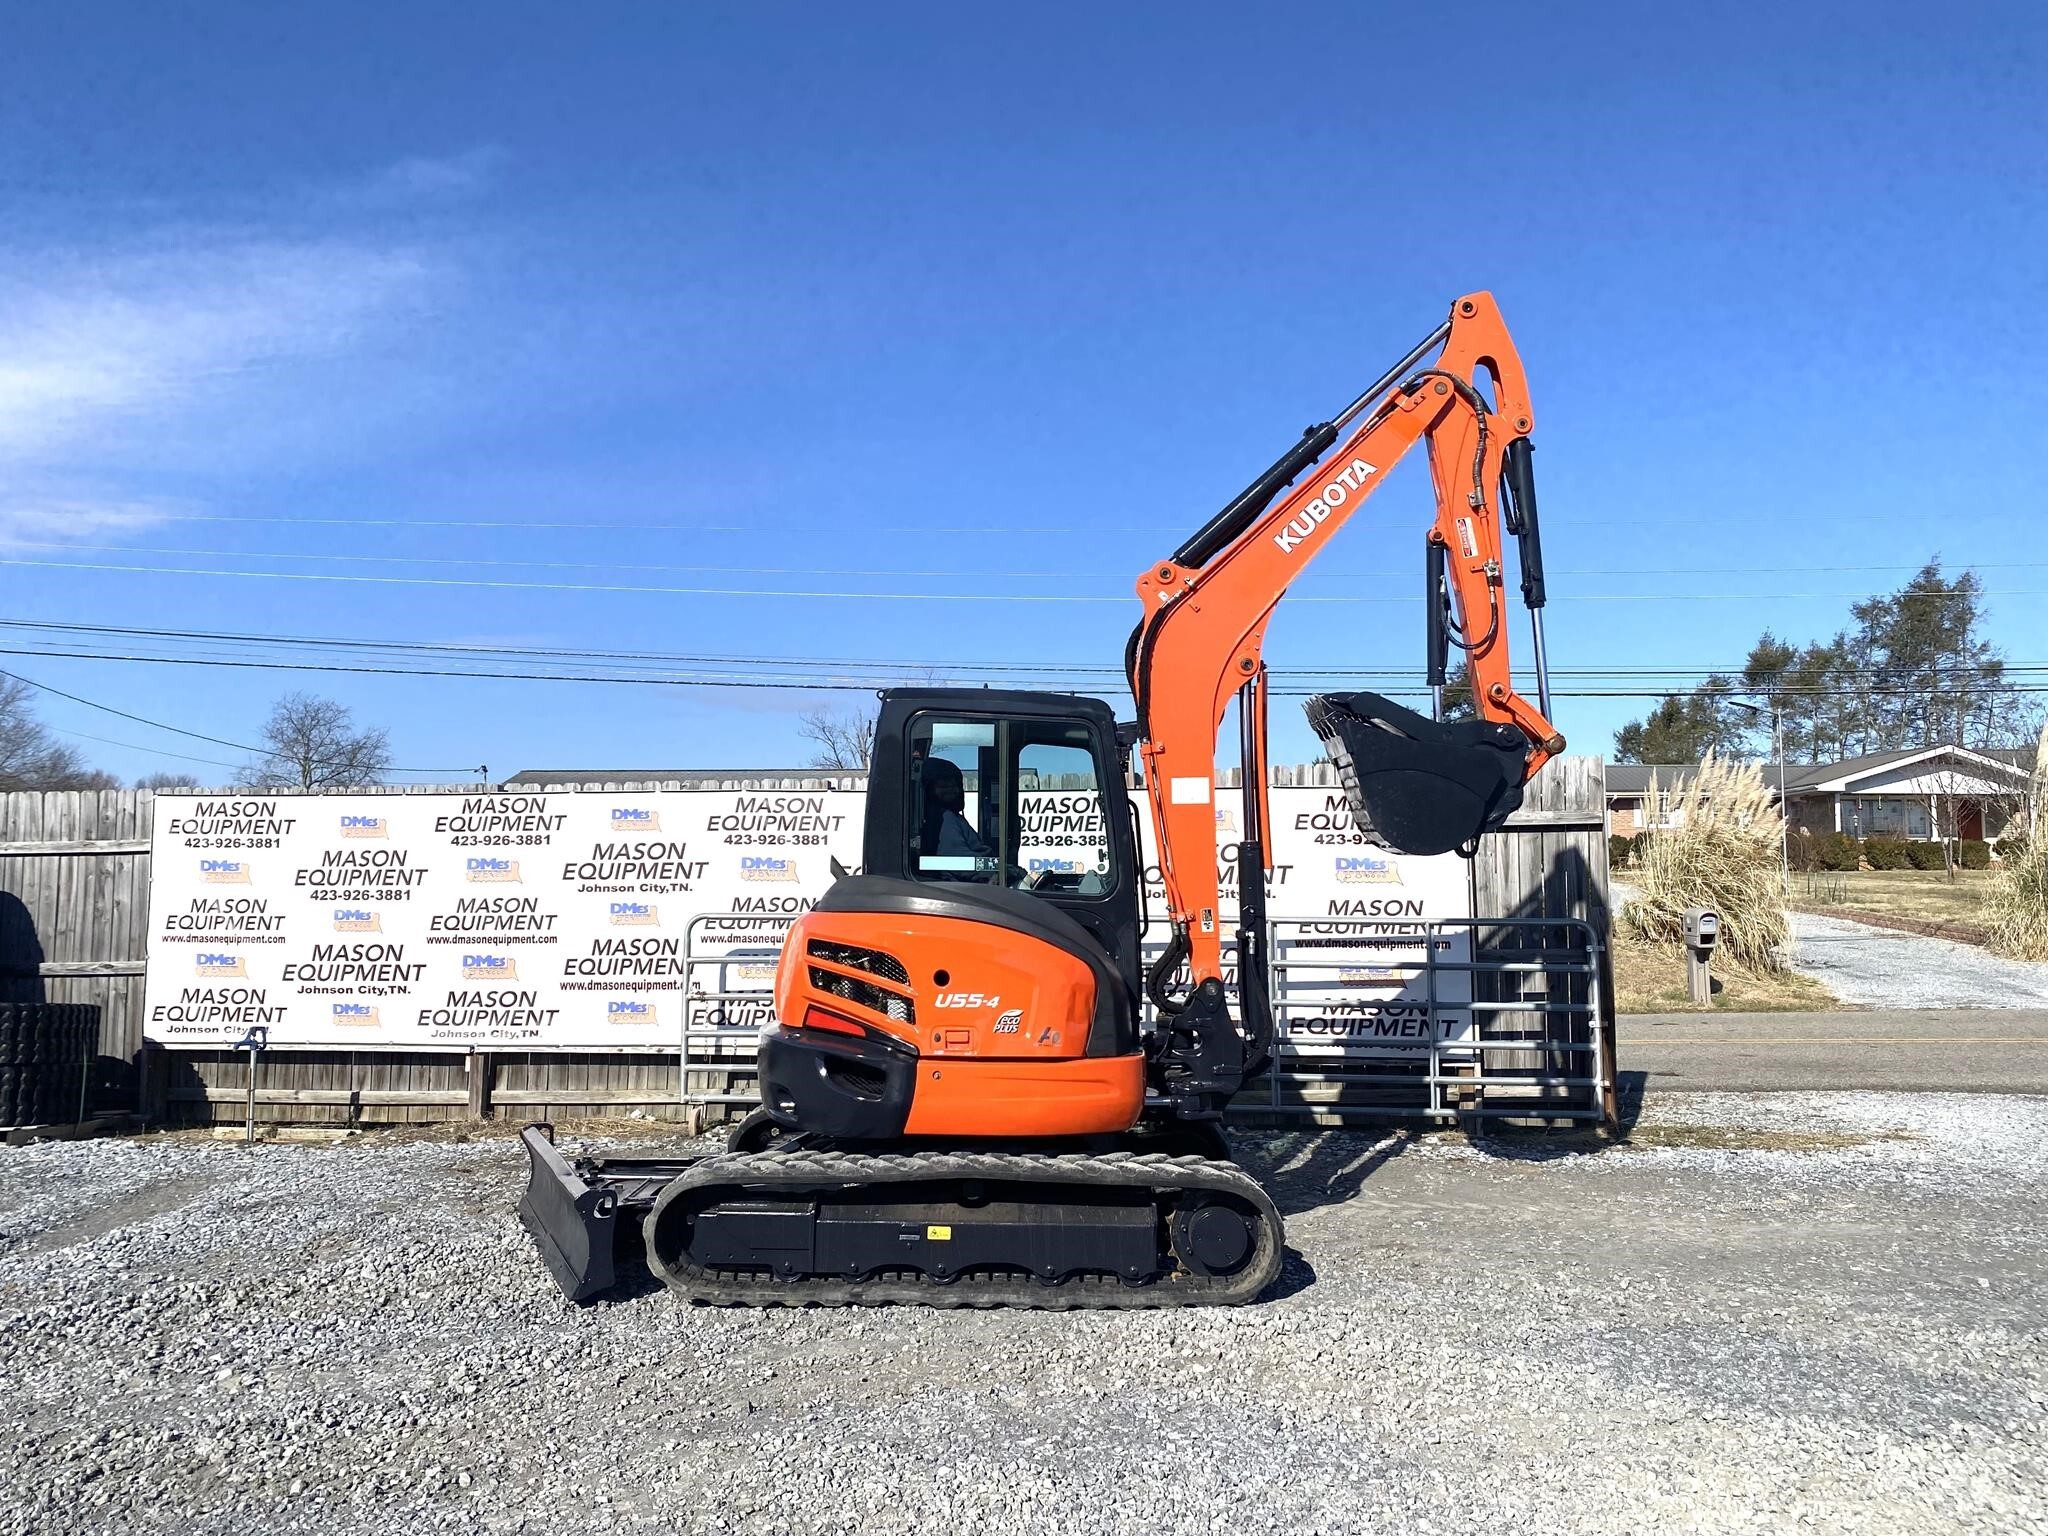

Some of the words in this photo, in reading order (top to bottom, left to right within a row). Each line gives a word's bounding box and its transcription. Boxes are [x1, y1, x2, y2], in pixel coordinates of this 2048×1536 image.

[1273, 458, 1378, 554] KUBOTA
[195, 802, 276, 817] MASON
[462, 798, 546, 814] MASON
[736, 798, 823, 813] MASON
[169, 819, 296, 834] EQUIPMENT
[435, 815, 567, 832] EQUIPMENT
[707, 815, 845, 831] EQUIPMENT
[185, 838, 279, 848] 423-926-3881
[451, 835, 550, 846] 423-926-3881
[724, 835, 827, 845] 423-926-3881
[1021, 835, 1107, 846] 23-926-388
[322, 850, 407, 867] MASON
[592, 843, 686, 860] MASON
[295, 869, 428, 886] EQUIPMENT
[563, 862, 709, 880] EQUIPMENT
[310, 890, 410, 900] 423-926-3881
[578, 884, 634, 892] Johnson
[640, 883, 692, 894] City,TN.
[191, 899, 267, 913] MASON
[457, 898, 537, 913] MASON
[732, 897, 816, 912] MASON
[1327, 899, 1424, 916] MASON
[166, 915, 285, 930] EQUIPMENT
[430, 915, 557, 930] EQUIPMENT
[705, 917, 791, 930] EQUIPM
[162, 933, 285, 945] www.dmasonequipment.com
[427, 934, 557, 946] www.dmasonequipment.com
[701, 933, 785, 945] www.dmasonequi
[1295, 938, 1451, 951] www.dmasonequipment.om
[312, 944, 403, 962] MASON
[592, 939, 679, 956] MASON
[282, 964, 427, 981] EQUIPMENT
[297, 986, 353, 994] Johnson
[358, 986, 411, 996] City,TN.
[560, 979, 700, 993] www.dmasonequipment.m
[180, 988, 266, 1004] MASON
[447, 991, 537, 1007] MASON
[934, 993, 1001, 1009] U55-4
[152, 1006, 287, 1022] EQUIPMENT
[418, 1010, 560, 1026] EQUIPMENT
[431, 1029, 486, 1038] Johnson
[490, 1029, 543, 1040] City,TN.
[995, 1024, 1019, 1033] PLUS
